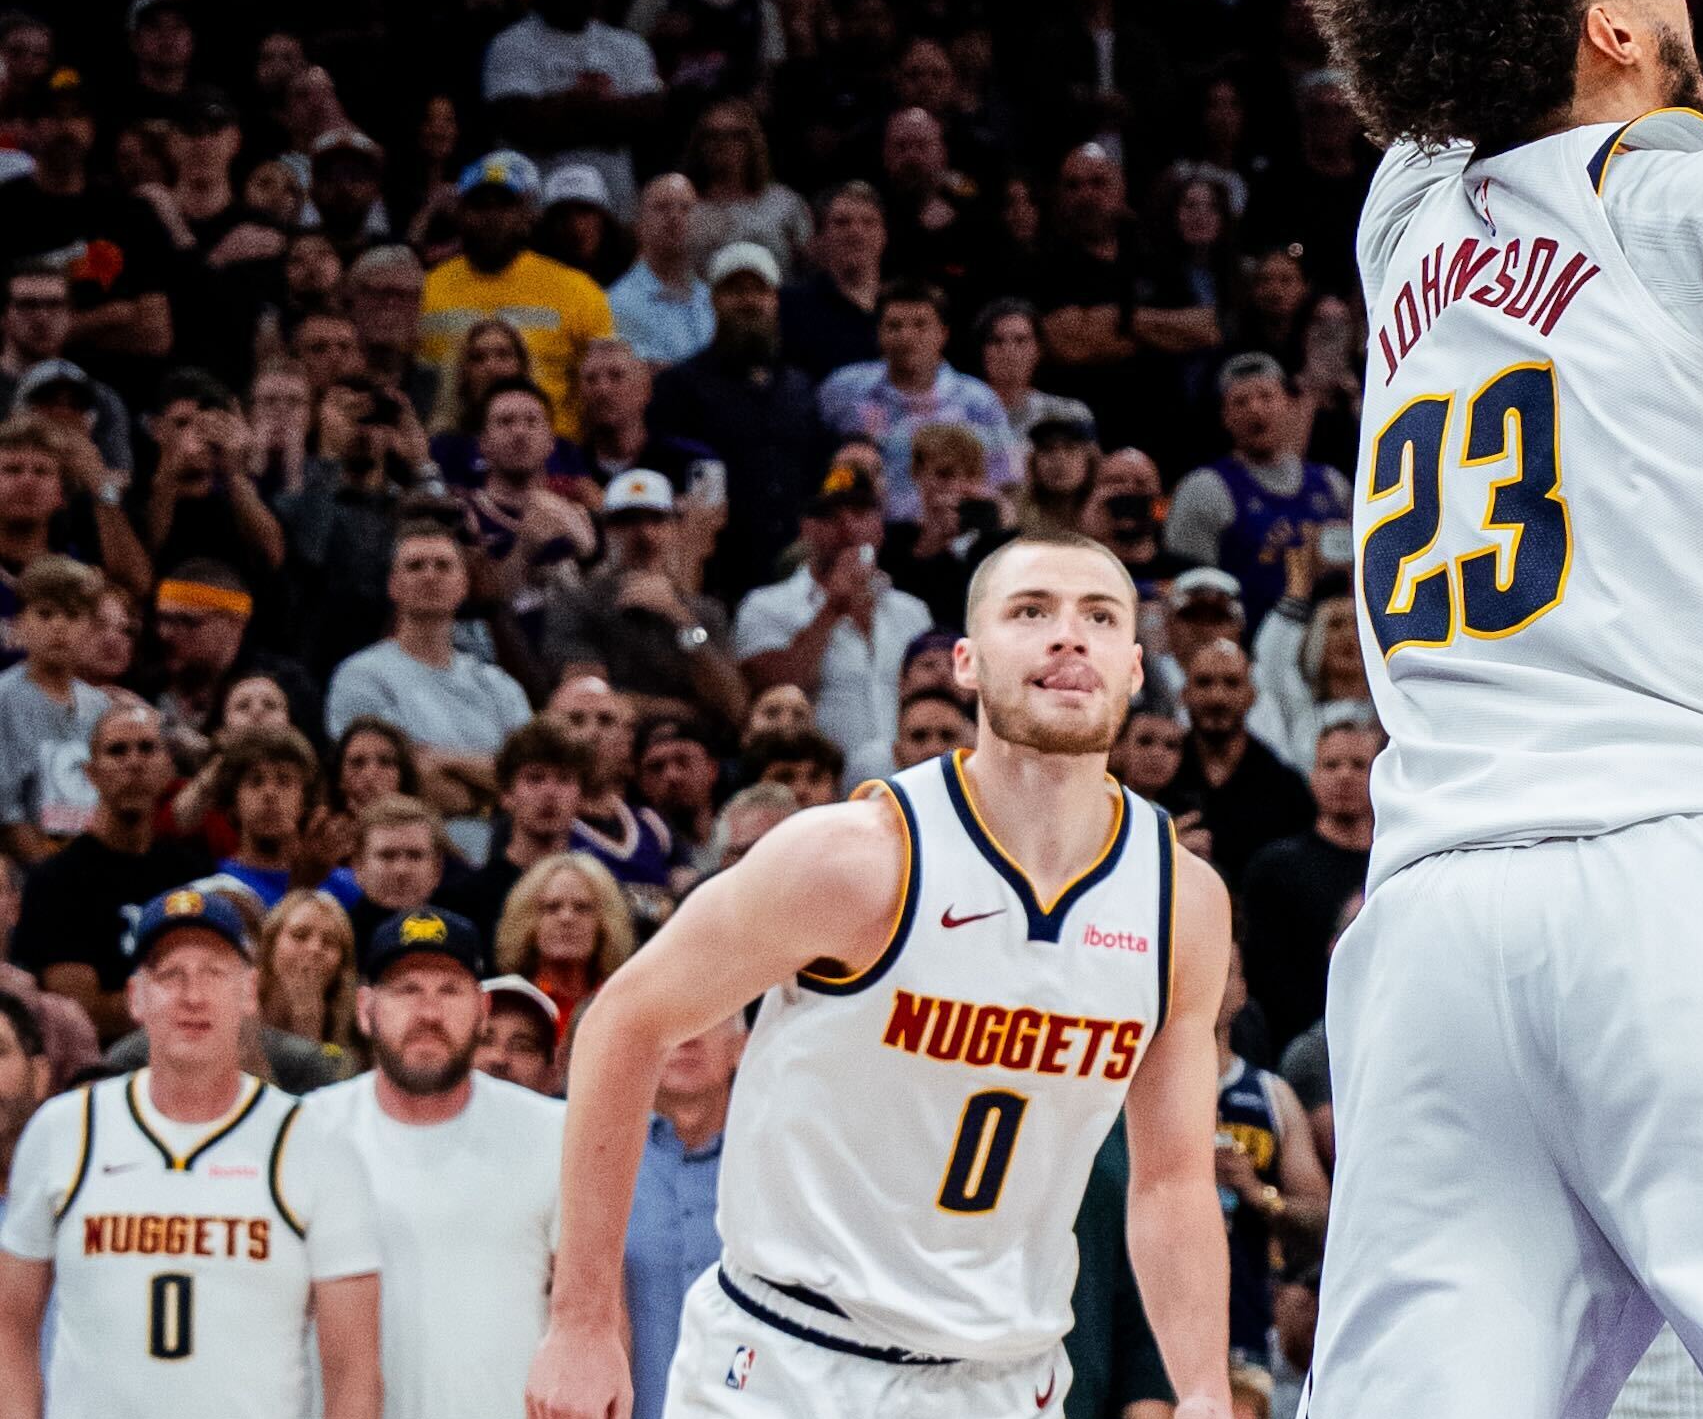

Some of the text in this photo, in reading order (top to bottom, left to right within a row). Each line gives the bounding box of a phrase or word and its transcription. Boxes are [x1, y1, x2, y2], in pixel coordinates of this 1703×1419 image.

[1378, 236, 1601, 388] JOHNSON
[1360, 358, 1574, 669] 23
[1083, 923, 1149, 954] ibotta
[882, 989, 1146, 1082] NUGGETS
[935, 1086, 1031, 1216] 0
[83, 1212, 272, 1262] NUGGETS
[146, 1271, 194, 1361] 0
